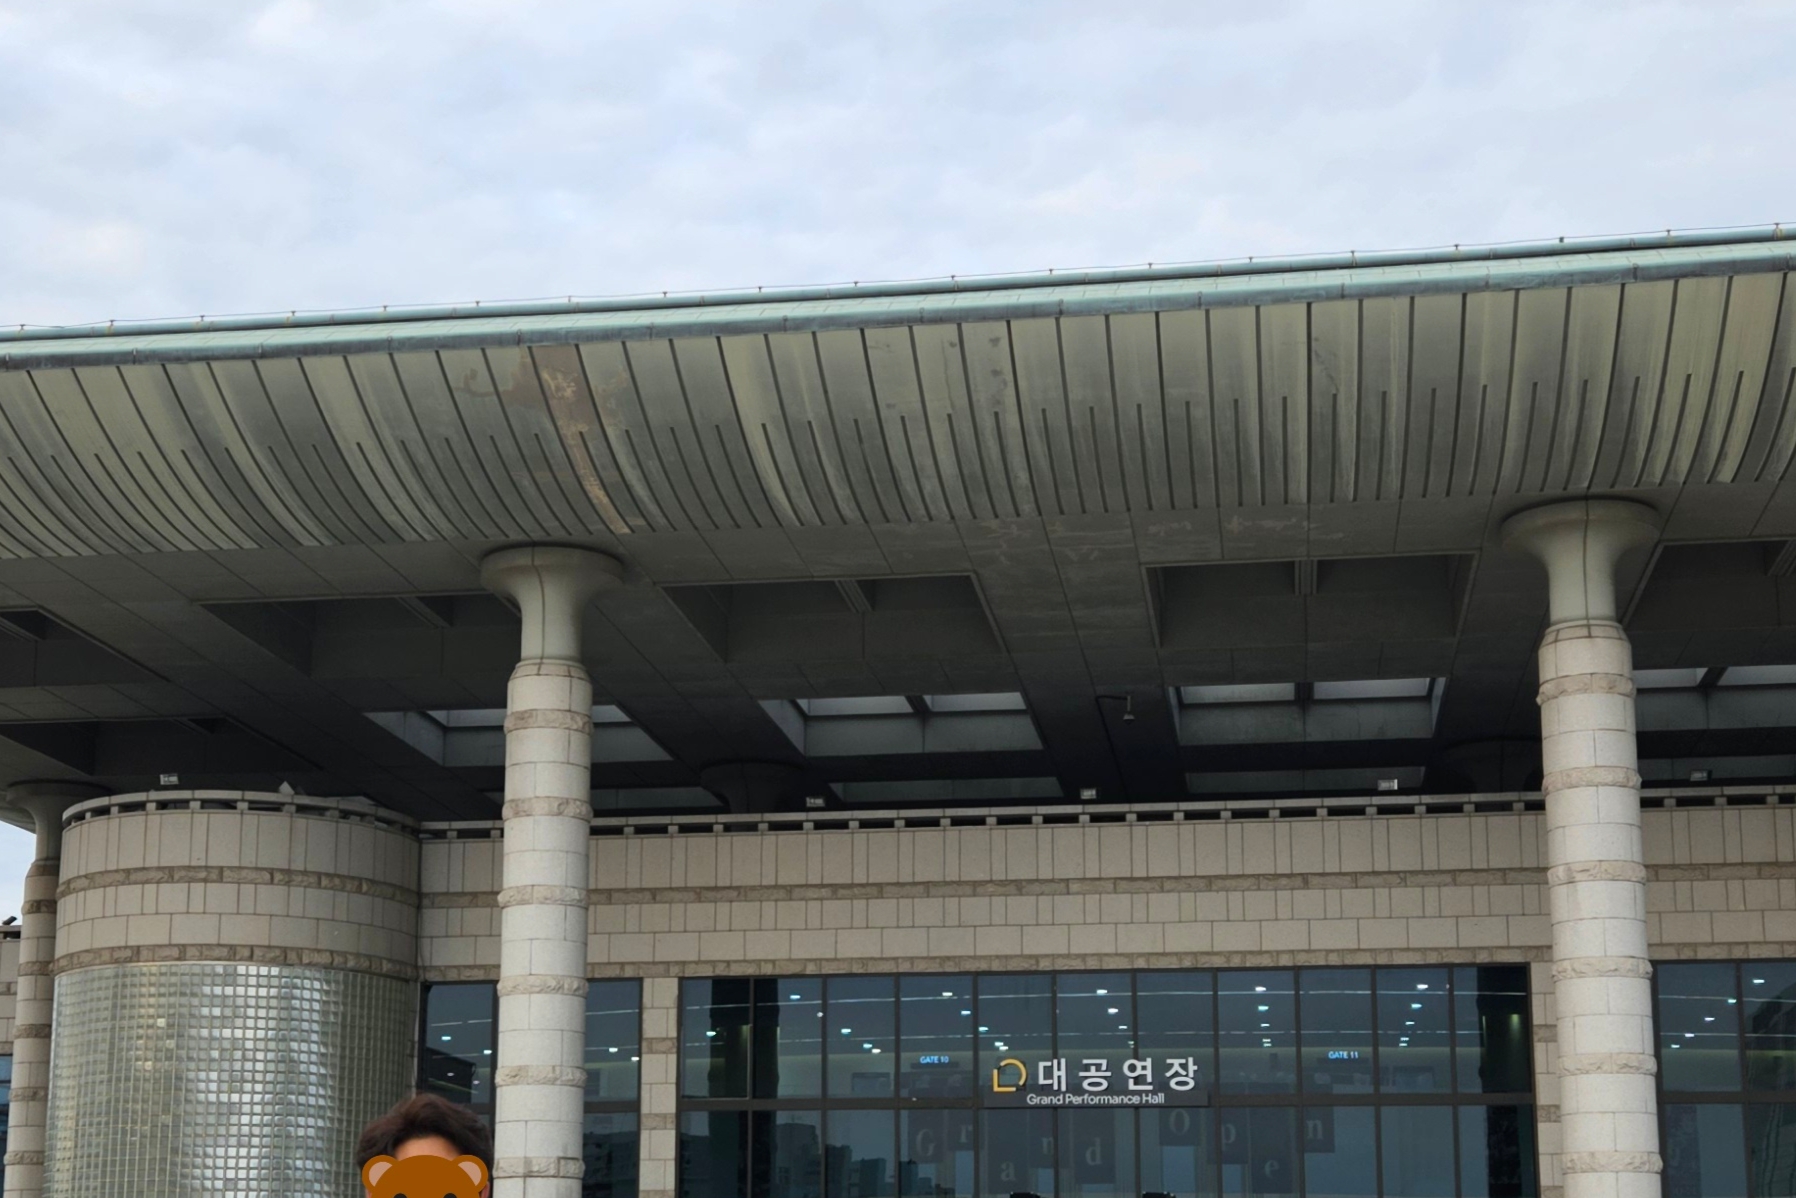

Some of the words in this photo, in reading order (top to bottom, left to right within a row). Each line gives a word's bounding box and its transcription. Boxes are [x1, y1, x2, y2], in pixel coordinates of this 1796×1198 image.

[920, 1055, 939, 1064] GATE
[1328, 1050, 1348, 1059] GATE
[1350, 1050, 1359, 1059] 11
[1038, 1057, 1198, 1092] 대공연장
[1026, 1093, 1063, 1105] Grand
[1065, 1093, 1141, 1106] Performance
[1144, 1092, 1165, 1105] Hall
